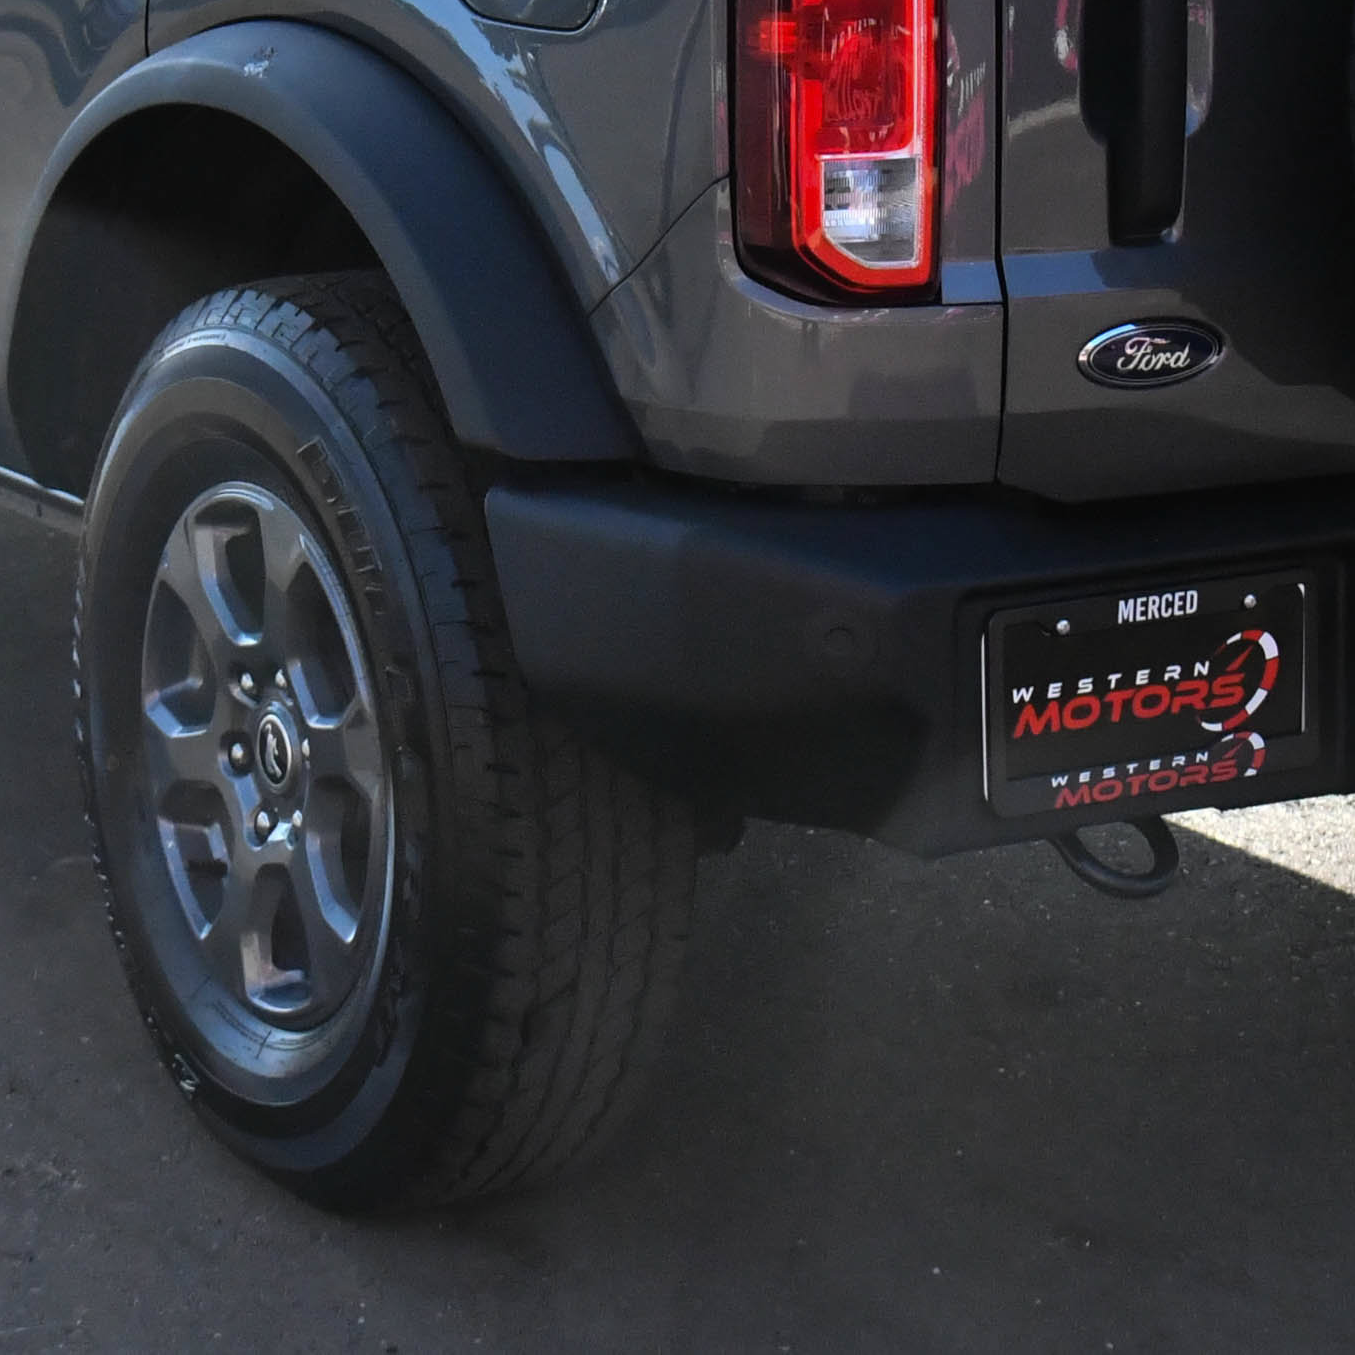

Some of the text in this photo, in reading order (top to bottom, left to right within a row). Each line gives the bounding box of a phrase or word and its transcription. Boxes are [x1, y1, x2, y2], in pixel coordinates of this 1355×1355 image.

[1117, 337, 1190, 371] Ford
[1118, 590, 1198, 624] MERCED
[1012, 660, 1210, 704] WESTERN
[1013, 673, 1245, 739] MOTORS
[1051, 751, 1209, 788] WESTERN
[1054, 759, 1238, 809] MOTORS
